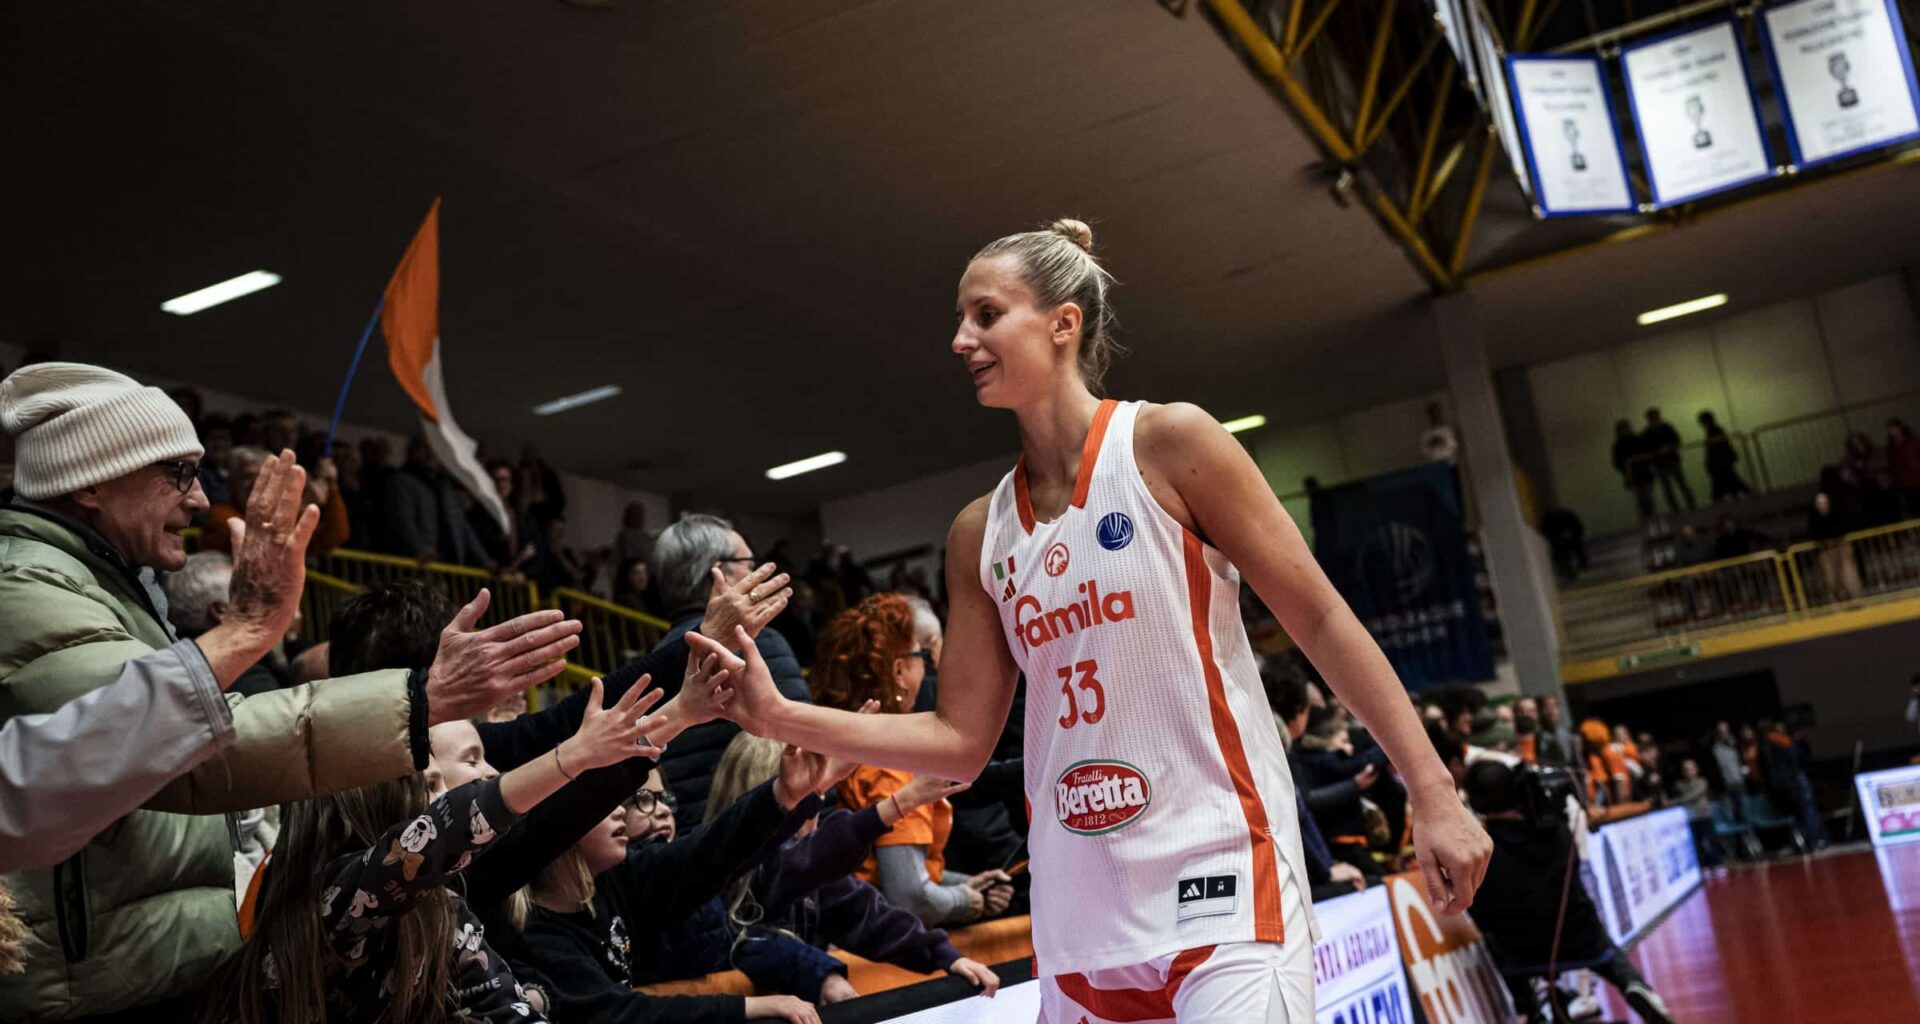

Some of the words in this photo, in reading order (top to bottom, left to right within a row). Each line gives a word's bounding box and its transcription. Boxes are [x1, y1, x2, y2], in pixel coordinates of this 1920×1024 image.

[1014, 580, 1135, 659] famila
[1057, 659, 1105, 729] 33
[1056, 774, 1146, 820] Beretta
[1072, 769, 1105, 785] Fratelli
[1084, 813, 1107, 827] 1812
